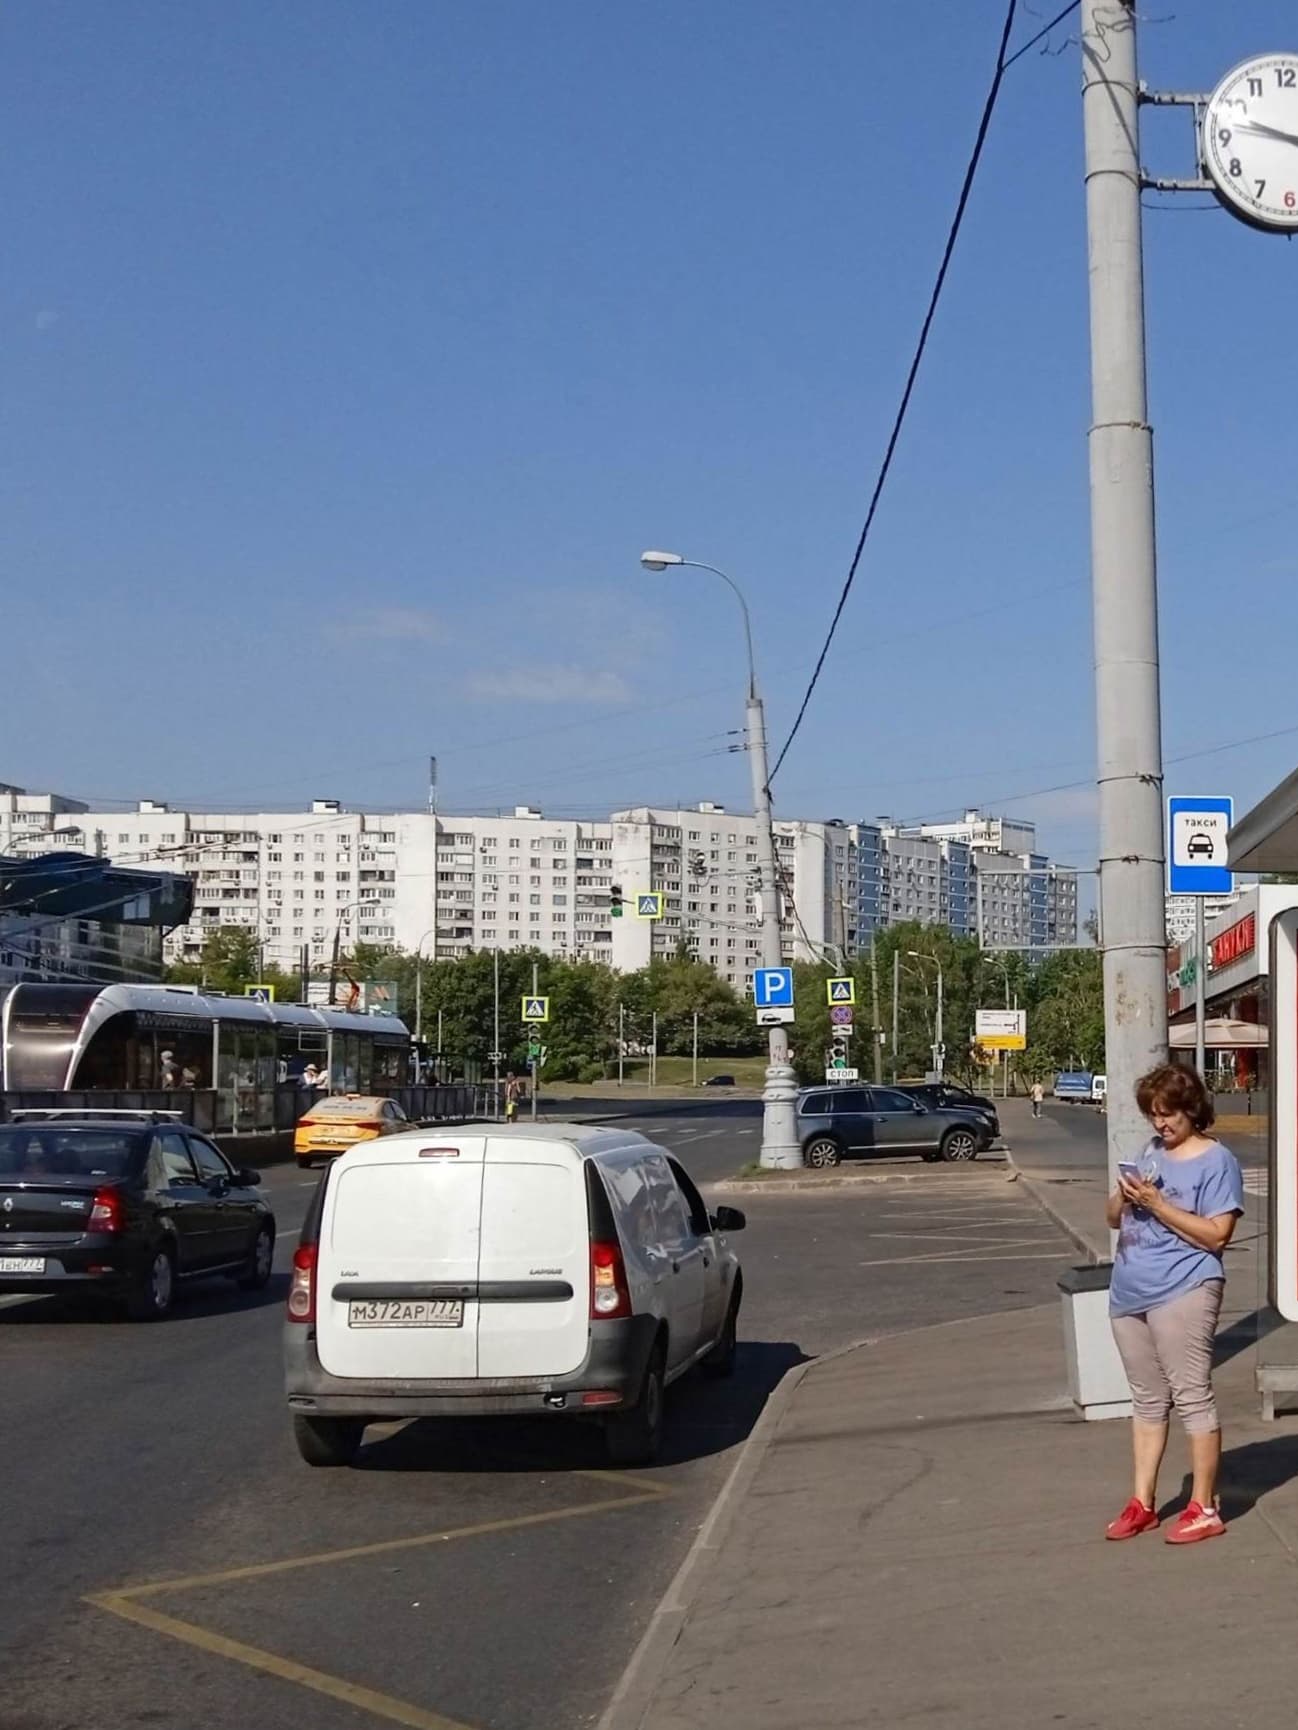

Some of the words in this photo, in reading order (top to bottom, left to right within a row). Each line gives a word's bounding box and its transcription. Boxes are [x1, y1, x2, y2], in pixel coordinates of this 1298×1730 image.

[1247, 78, 1262, 97] 11
[1274, 68, 1296, 88] 12
[1218, 129, 1232, 148] 9
[1229, 158, 1242, 177] 8
[1254, 180, 1266, 199] 7
[1284, 191, 1296, 208] 6
[353, 1301, 425, 1319] М372АР
